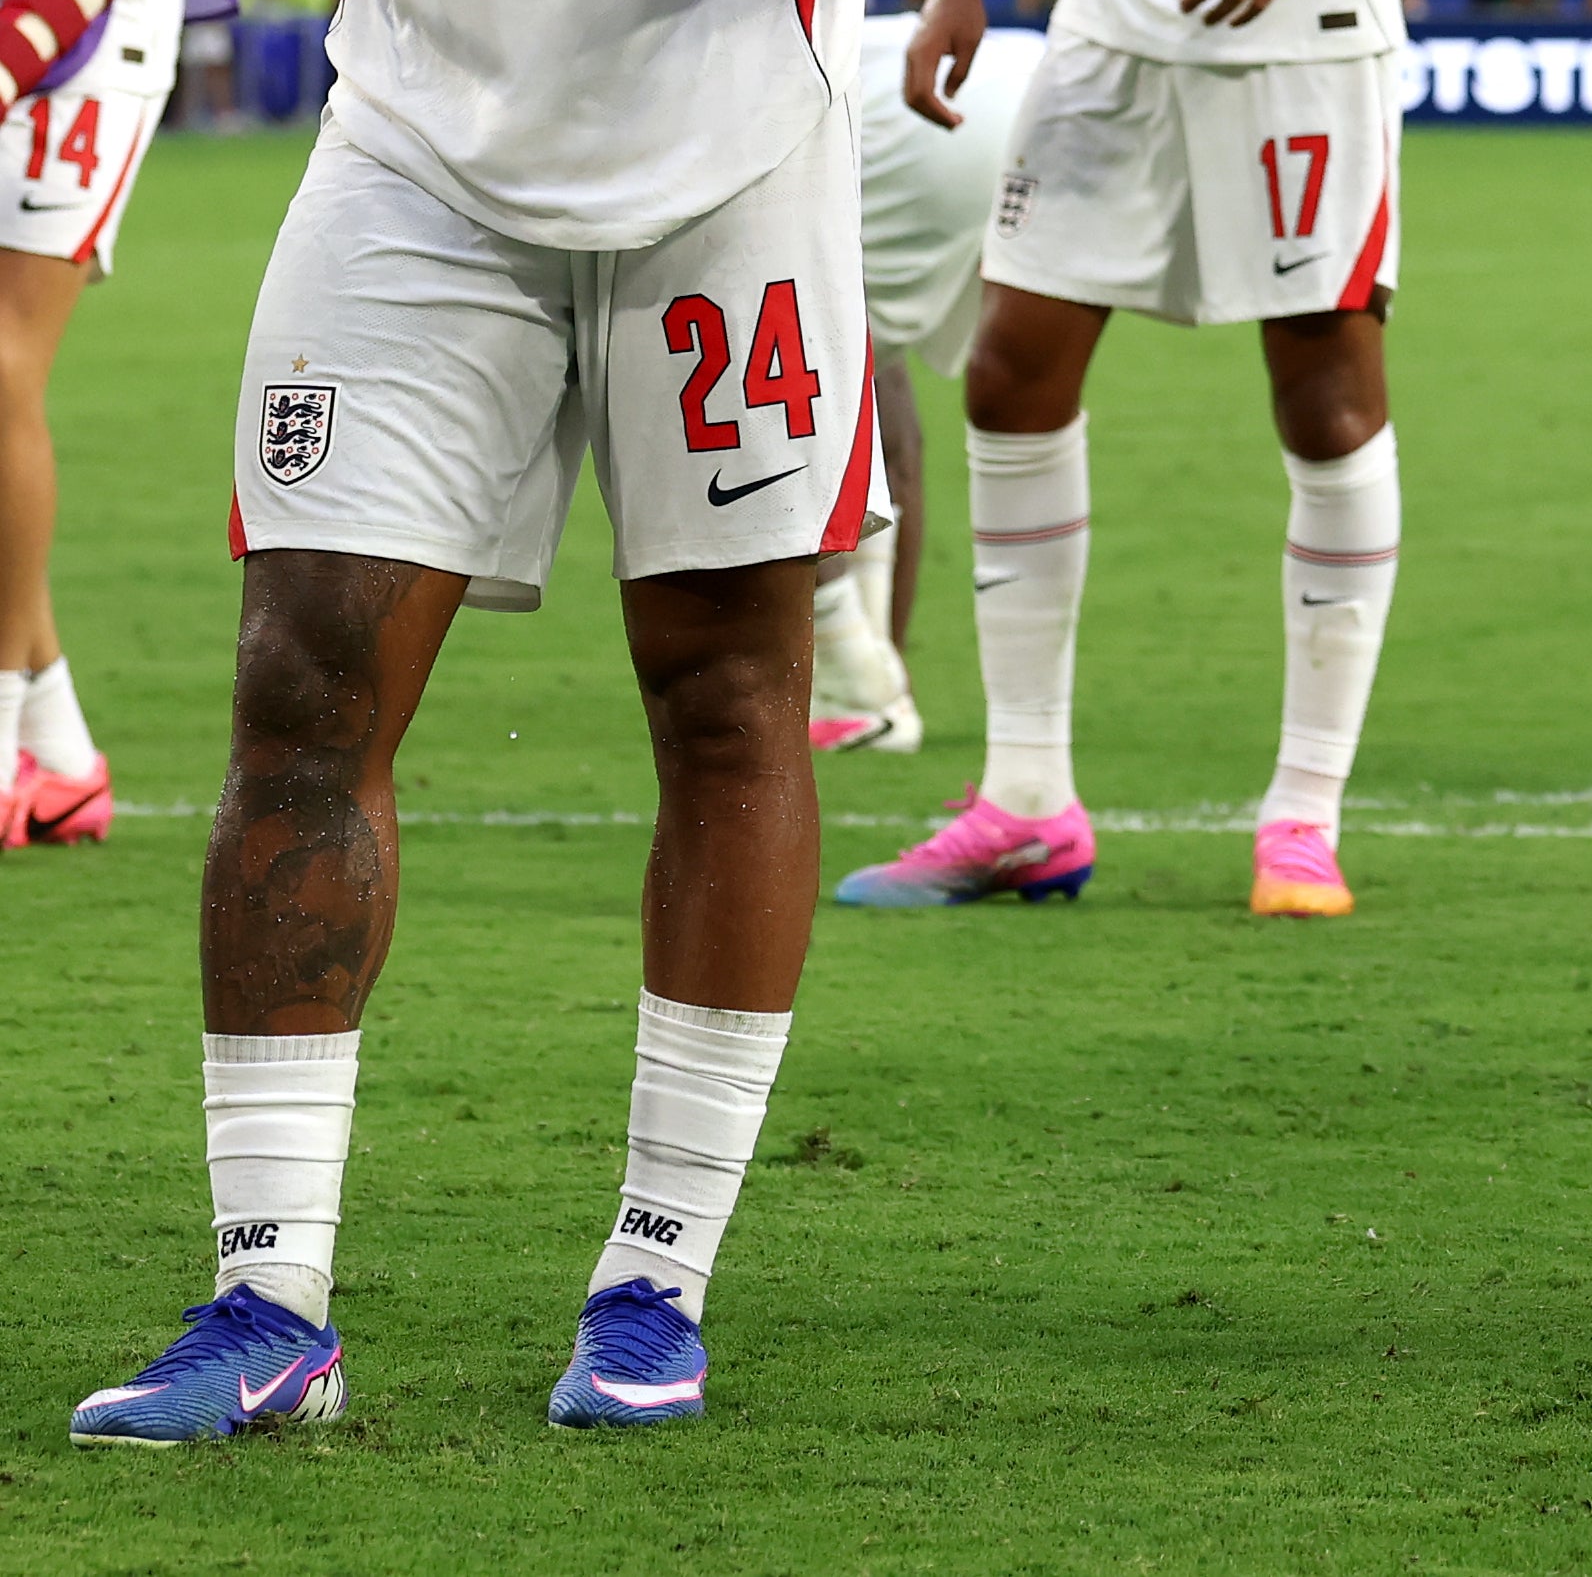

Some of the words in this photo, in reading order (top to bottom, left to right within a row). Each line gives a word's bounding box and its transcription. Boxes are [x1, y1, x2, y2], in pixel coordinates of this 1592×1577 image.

[26, 97, 101, 189] 14
[1259, 133, 1331, 239] 17
[661, 278, 822, 454] 24
[219, 1222, 280, 1259] ENG
[619, 1206, 684, 1247] ENG
